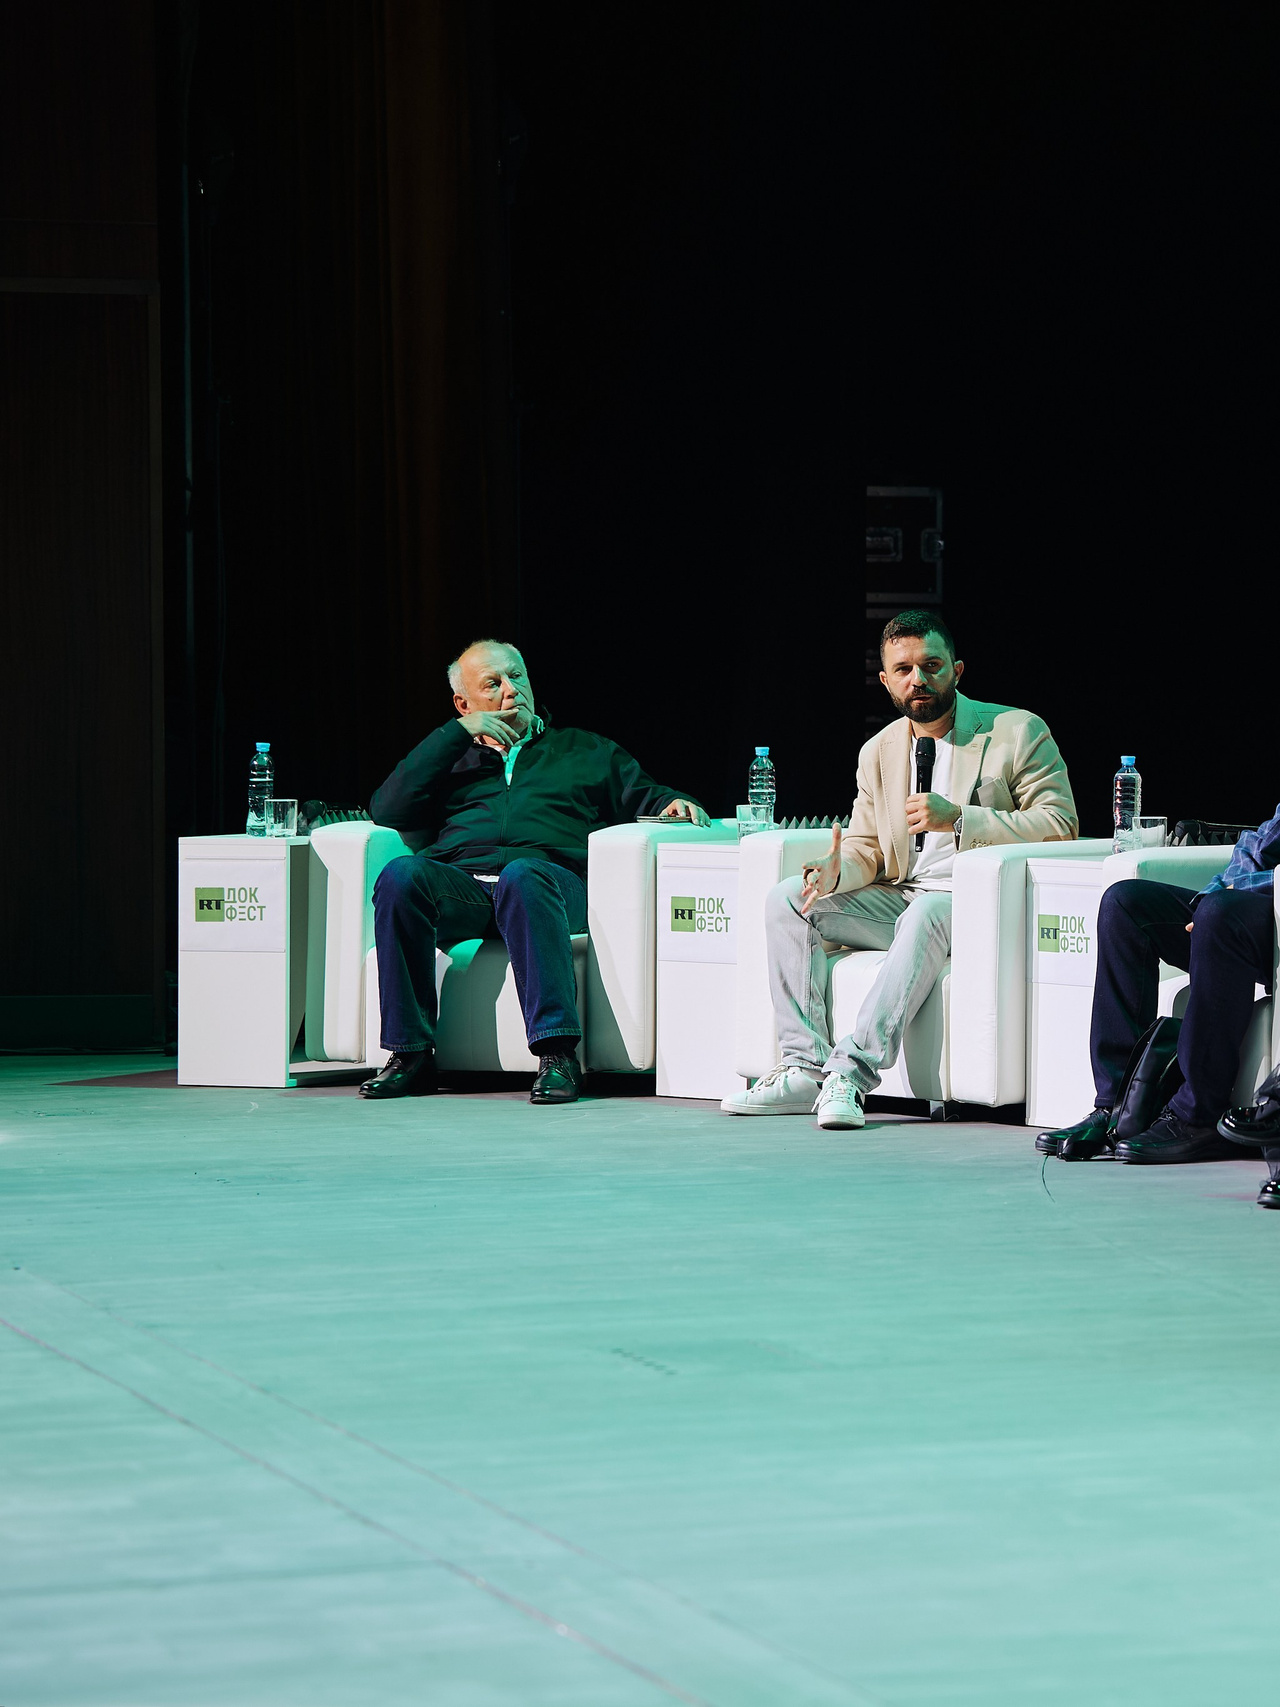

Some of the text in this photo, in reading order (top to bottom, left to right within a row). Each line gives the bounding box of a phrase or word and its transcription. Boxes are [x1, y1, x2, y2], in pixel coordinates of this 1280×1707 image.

[225, 887, 259, 903] ДОК
[199, 899, 225, 910] RT
[696, 897, 725, 914] ДОК
[226, 905, 266, 922] ФЕСТ
[674, 908, 696, 920] RT
[696, 915, 731, 932] ФЕСТ
[1060, 915, 1085, 934] ДОК
[1040, 927, 1060, 939] RT
[1060, 935, 1090, 953] ФЕСТ
